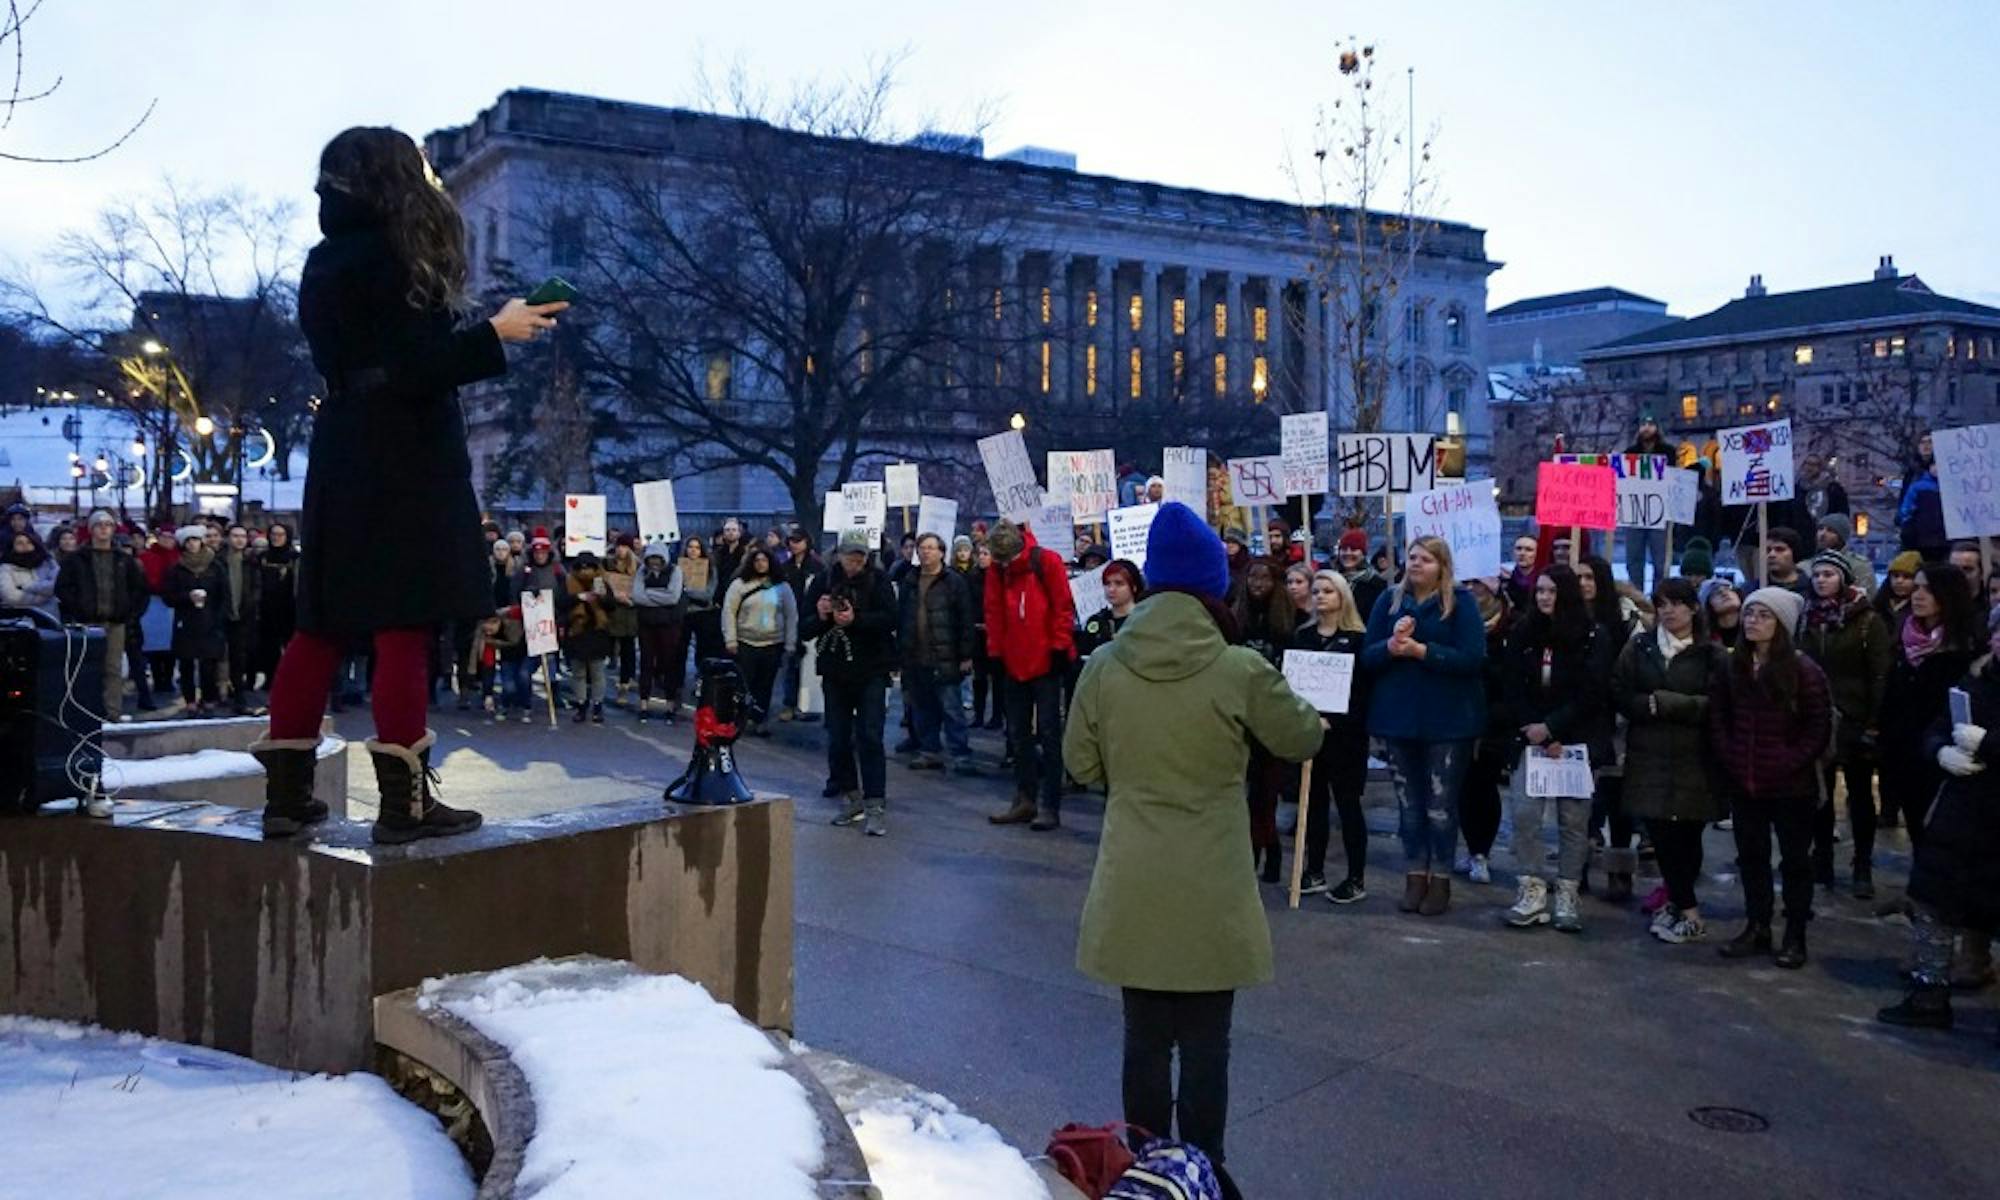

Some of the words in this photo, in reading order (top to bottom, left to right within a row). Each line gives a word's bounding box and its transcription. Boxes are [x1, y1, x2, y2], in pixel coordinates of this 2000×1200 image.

[1956, 428, 1989, 452] NO
[1339, 435, 1435, 493] #BLM
[1961, 475, 1993, 495] NO
